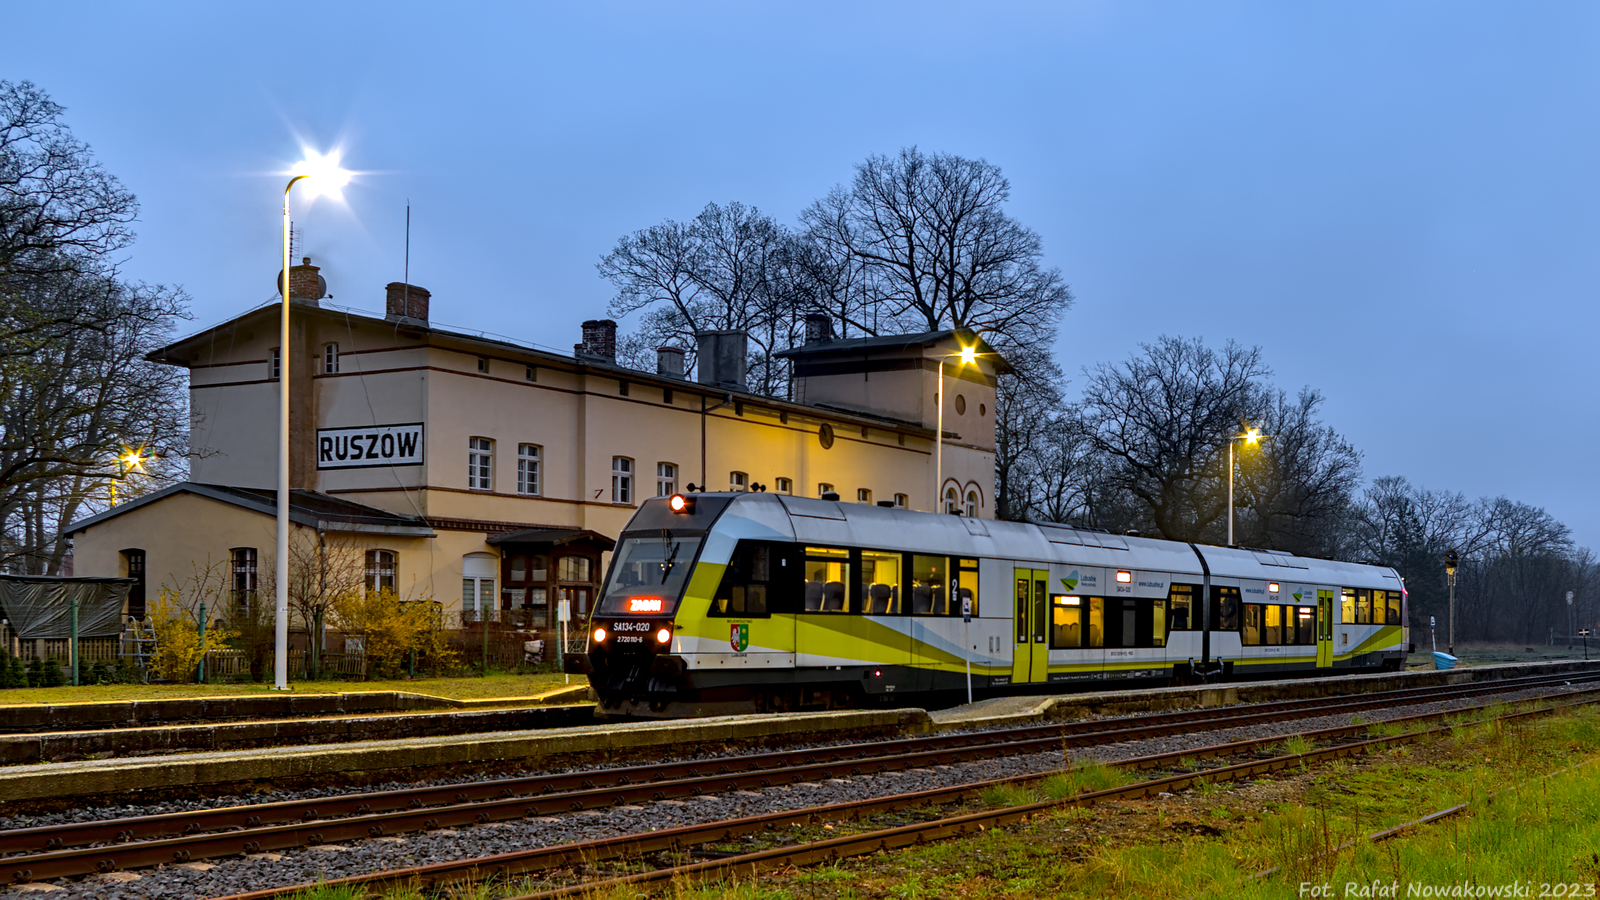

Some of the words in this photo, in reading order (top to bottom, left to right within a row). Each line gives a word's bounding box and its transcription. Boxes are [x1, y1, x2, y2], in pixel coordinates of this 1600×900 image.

[320, 427, 419, 462] RUSZÓW
[952, 578, 958, 594] 2
[613, 622, 651, 632] SA134-020
